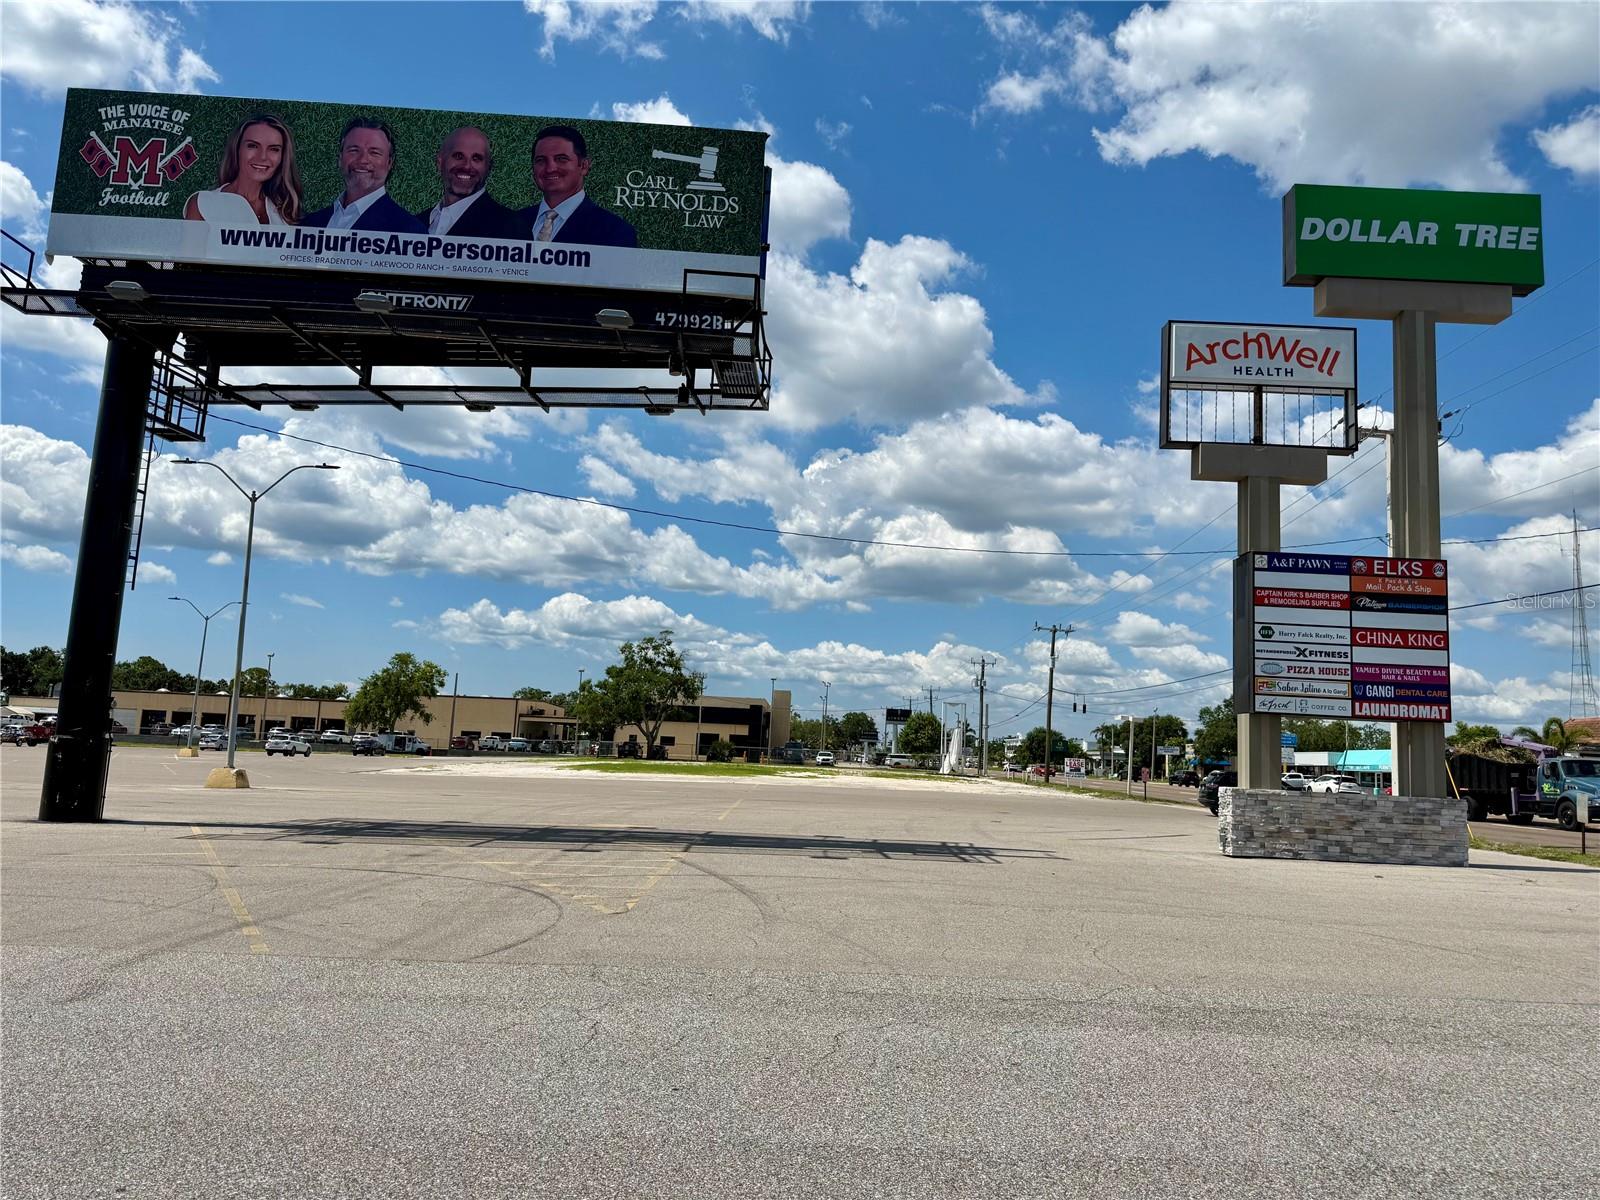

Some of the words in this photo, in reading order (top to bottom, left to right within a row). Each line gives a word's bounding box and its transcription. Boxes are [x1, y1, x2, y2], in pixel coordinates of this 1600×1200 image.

[98, 104, 126, 120] THE
[128, 103, 170, 119] VOICE
[171, 109, 191, 123] OF
[101, 118, 185, 136] MANATEE
[109, 135, 167, 187] M
[626, 169, 679, 191] CARL
[98, 187, 170, 206] Football
[613, 186, 739, 214] REYNOLDS
[682, 211, 726, 229] LAW
[1300, 217, 1439, 245] DOLLAR
[1455, 223, 1540, 251] TREE
[220, 228, 591, 268] www.InjuriesArePersonal.com
[279, 254, 315, 263] OFFICES:
[315, 256, 362, 266] BRADENTON
[370, 260, 415, 269] LAKEWOOD
[416, 263, 444, 271] RANCH
[452, 265, 494, 274] SARASOTA
[502, 268, 529, 276] VENICE
[1185, 331, 1341, 377] ArchWell
[1233, 366, 1294, 377] HEALTH
[1271, 558, 1296, 568] A&F
[1298, 558, 1331, 569] PAWN
[1373, 560, 1423, 577] ELKS
[1256, 589, 1283, 598] CAPTAIN
[1387, 583, 1405, 592] Pack
[1414, 586, 1432, 595] Ship
[1269, 598, 1310, 606] REMODELING
[1278, 630, 1296, 638] Harry
[1315, 632, 1335, 640] Realty,
[1355, 631, 1403, 646] CHINA
[1408, 633, 1445, 647] KING
[1308, 650, 1349, 659] FITNESS
[1286, 665, 1316, 675] PIZZA
[1318, 667, 1350, 676] HOUSE
[1355, 666, 1380, 674] YAMIES
[1381, 667, 1405, 675] DIVINE
[1365, 684, 1395, 698] GANGI
[1395, 688, 1425, 697] DENTAL
[1426, 690, 1448, 698] CARE
[1354, 702, 1449, 720] LAUNDROMAT
